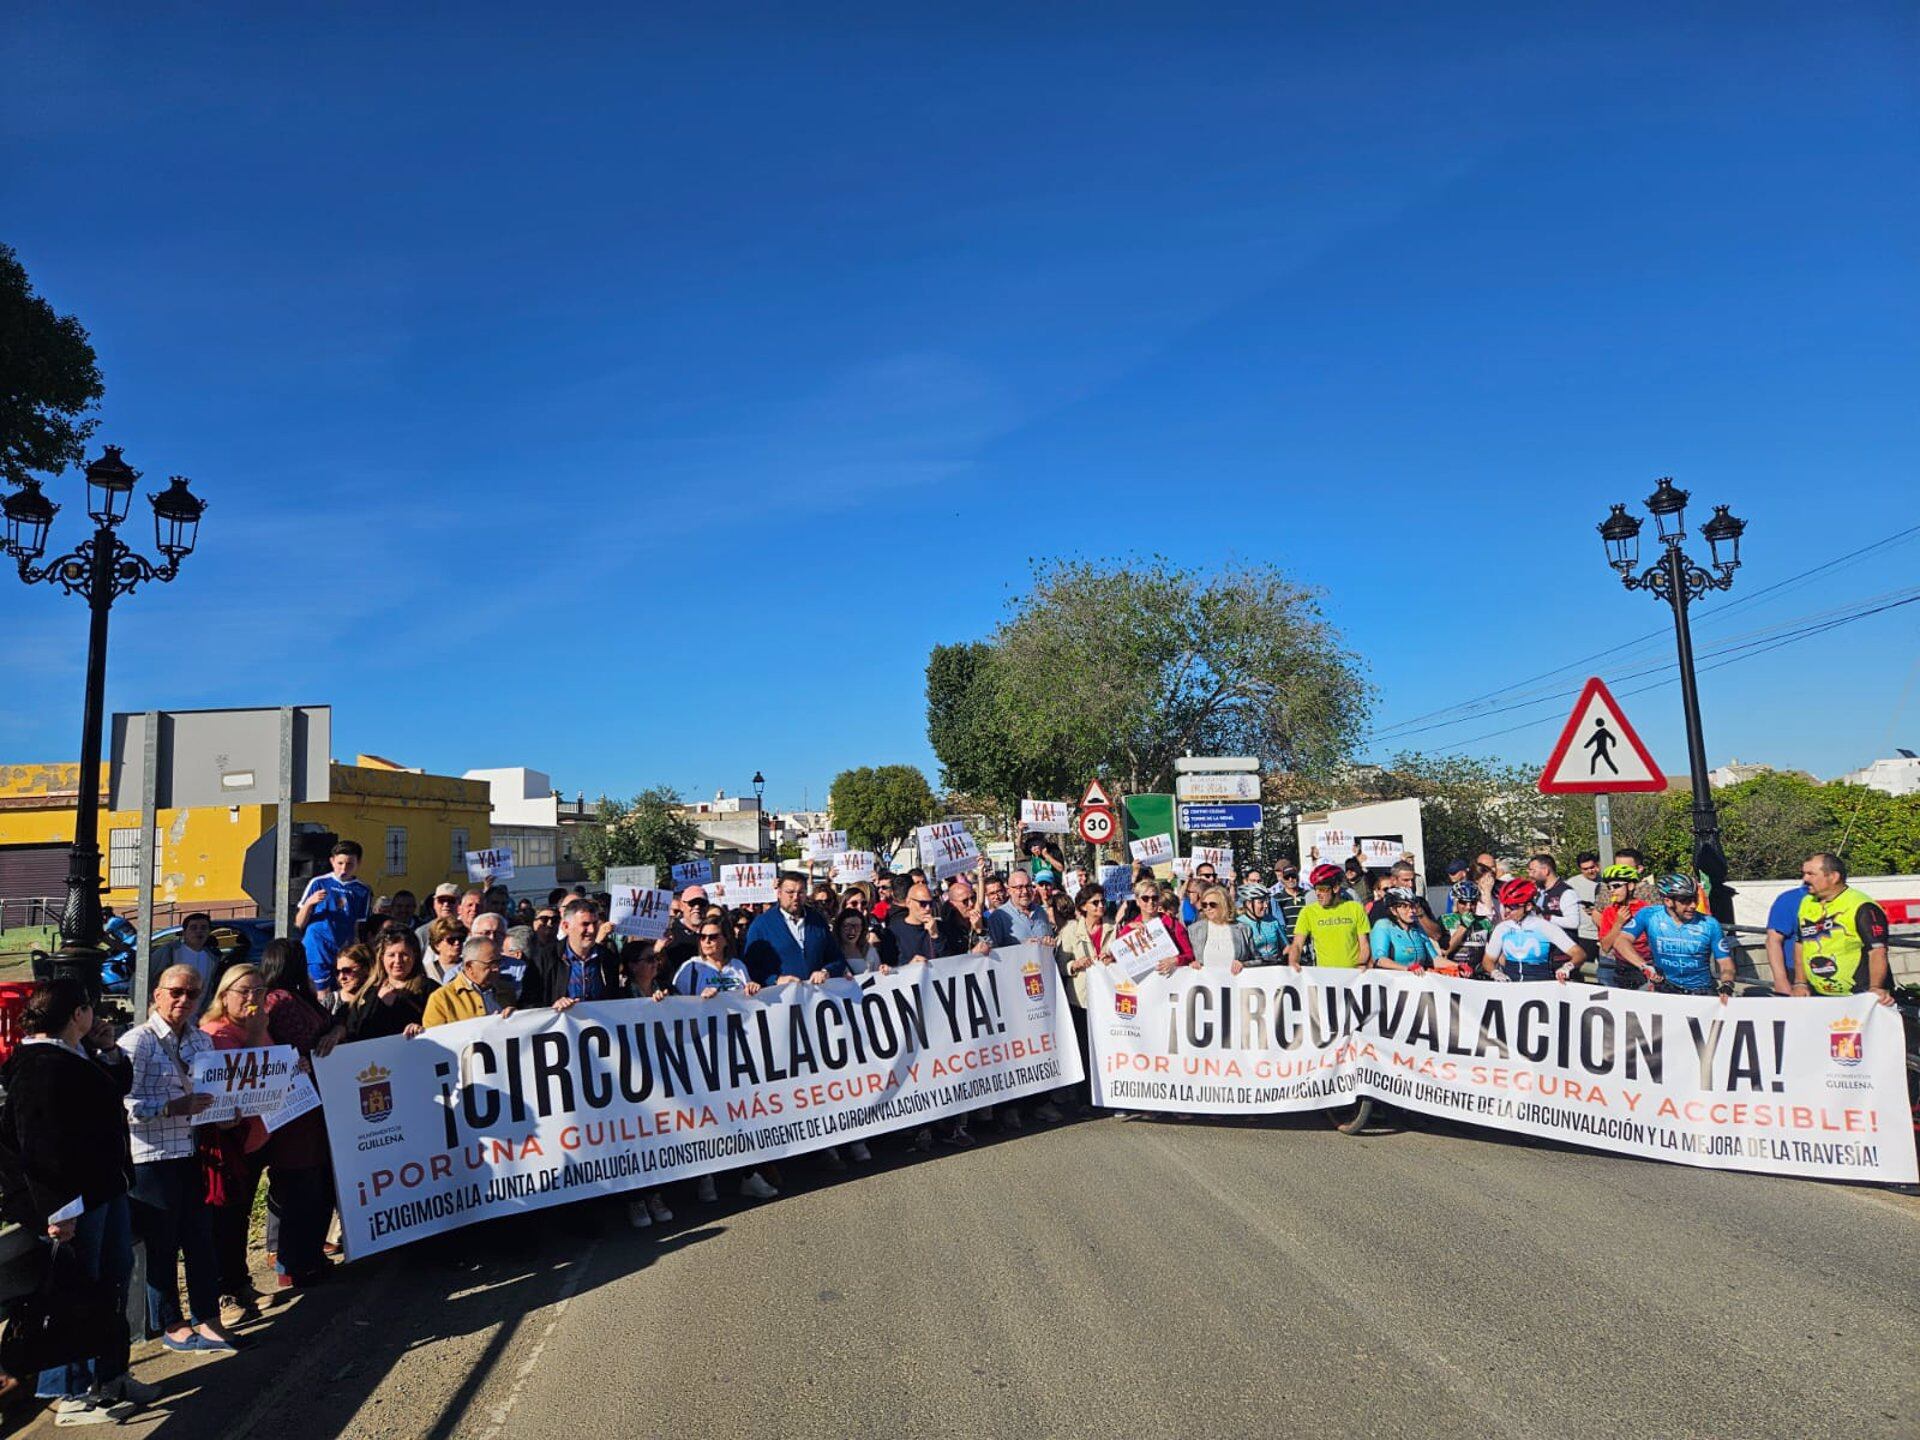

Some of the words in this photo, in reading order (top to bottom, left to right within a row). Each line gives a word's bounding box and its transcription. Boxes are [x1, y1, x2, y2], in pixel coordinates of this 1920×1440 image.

[1032, 802, 1056, 822] YA!
[1087, 814, 1108, 831] 30
[819, 832, 839, 848] YA!
[942, 836, 969, 861] YA!
[1140, 837, 1163, 857] YA!
[1324, 831, 1345, 845] YA!
[1373, 841, 1393, 856] YA!
[478, 849, 501, 869] YA!
[844, 854, 864, 870] YA!
[681, 862, 702, 880] YA!
[735, 865, 763, 887] YA!
[631, 888, 662, 919] YA!
[1318, 917, 1353, 926] adidas
[1123, 926, 1157, 957] YA!
[1169, 984, 1663, 1085] ¡CIRCUNVALACIÓN
[1686, 1016, 1786, 1092] YA!
[435, 976, 929, 1149] ¡CIRCUNVALACIÓN
[932, 969, 1005, 1043] YA!
[224, 1050, 270, 1092] YA!
[1107, 1053, 1169, 1074] ¡POR
[1184, 1056, 1242, 1077] UNA
[1255, 1041, 1378, 1079] GUILLENA
[1393, 1052, 1457, 1080] MÁS
[1472, 1066, 1608, 1107] SEGURA
[1622, 1091, 1642, 1112] Y
[1657, 1098, 1878, 1132] ACCESIBLE!
[358, 1154, 453, 1206] ¡POR
[464, 1134, 544, 1171] UNA
[560, 1106, 718, 1150] GUILLENA
[727, 1091, 783, 1122] MÁS
[794, 1070, 900, 1109] SEGURA
[907, 1063, 919, 1083] Y
[932, 1032, 1057, 1078] ACCESIBLE!
[1110, 1080, 1167, 1099] ¡EXIGIMOS
[1169, 1084, 1177, 1100] A
[1180, 1085, 1194, 1101] LA
[1196, 1086, 1236, 1104] JUNTA
[1237, 1087, 1251, 1104] DE
[1254, 1077, 1321, 1104] ANDALUCÍA
[1322, 1075, 1337, 1096] LA
[1415, 1083, 1474, 1111] URGENTE
[1477, 1096, 1494, 1115] DE
[1496, 1099, 1513, 1118] LA
[1517, 1101, 1643, 1143] CIRCUNVALACIÓN
[1648, 1126, 1657, 1146] Y
[1660, 1128, 1677, 1149] LA
[1681, 1132, 1742, 1157] MEJORA
[1747, 1136, 1769, 1158] DE
[1771, 1140, 1790, 1161] LA
[1792, 1140, 1879, 1167] TRAVESÍA!
[358, 1134, 405, 1151] GUILLENA
[368, 1192, 454, 1241] ¡EXIGIMOS
[456, 1188, 464, 1213] A
[465, 1183, 482, 1209] LA
[485, 1173, 537, 1204] JUNTA
[540, 1168, 561, 1193] DE
[563, 1148, 640, 1188] ANDALUCÍA
[642, 1149, 657, 1172] LA
[659, 1129, 756, 1168] CONSTRUCCIÓN
[757, 1121, 806, 1149] URGENTE
[806, 1118, 823, 1138] DE
[824, 1115, 837, 1135] LA
[838, 1090, 931, 1132] CIRCUNVALACIÓN
[929, 1087, 938, 1108] Y
[938, 1085, 953, 1105] LA
[953, 1077, 991, 1101] MEJORA
[992, 1073, 1005, 1091] DE
[1004, 1070, 1016, 1088] LA
[1015, 1058, 1062, 1084] TRAVESÍA!
